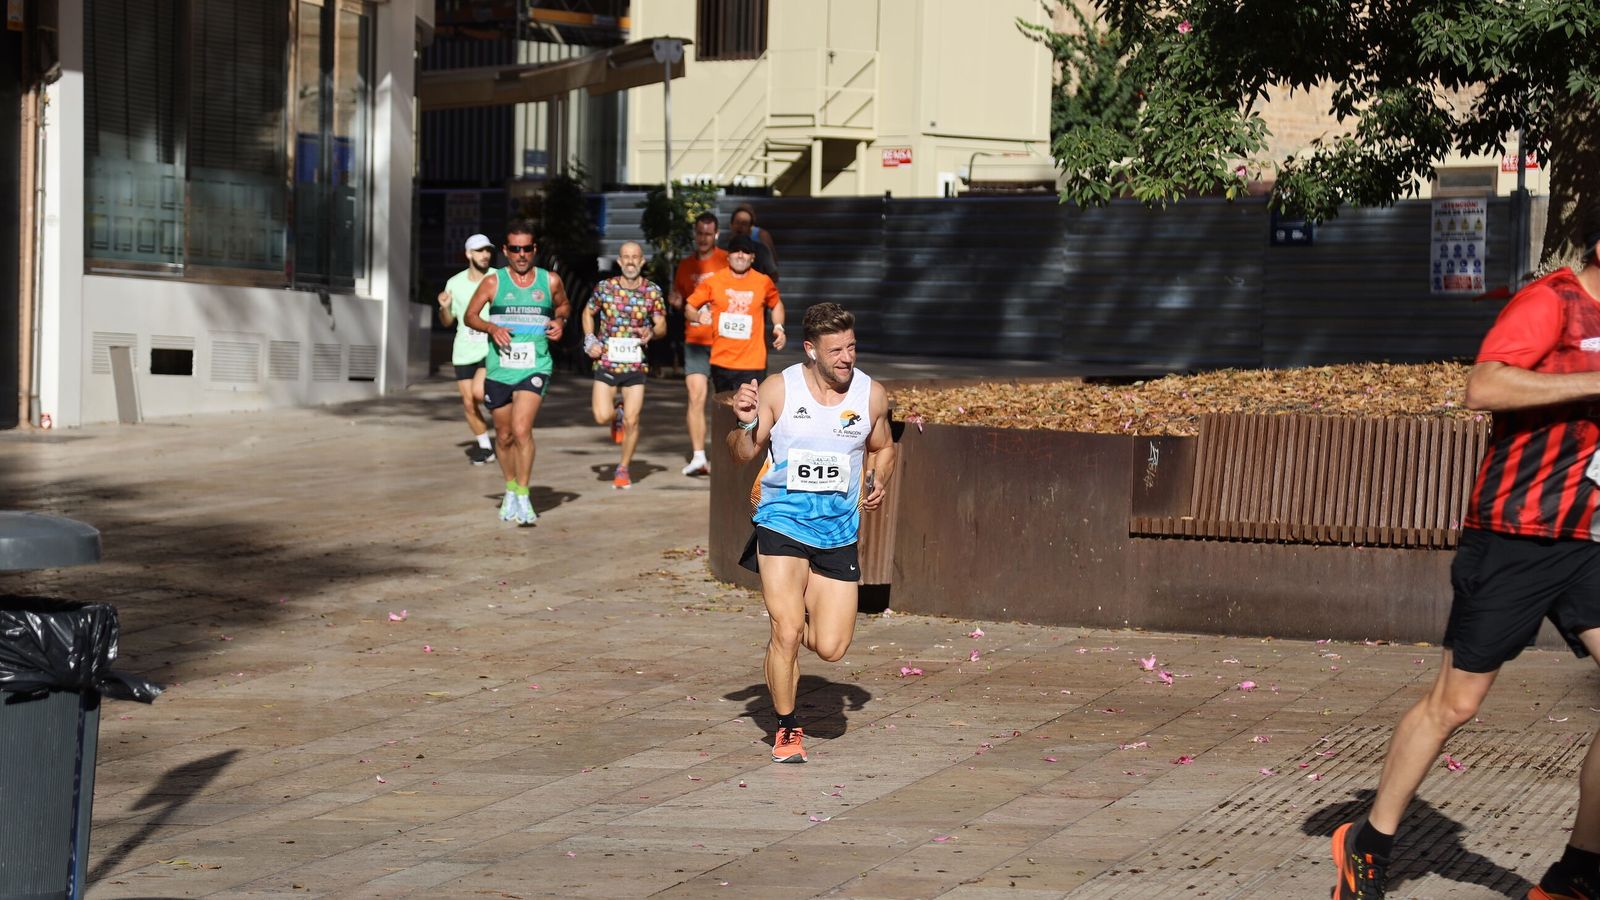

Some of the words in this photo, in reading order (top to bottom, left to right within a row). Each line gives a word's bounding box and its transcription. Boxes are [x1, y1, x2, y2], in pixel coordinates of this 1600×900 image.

[505, 306, 542, 315] ATLETISMO
[724, 321, 746, 332] 622
[797, 464, 840, 479] 615
